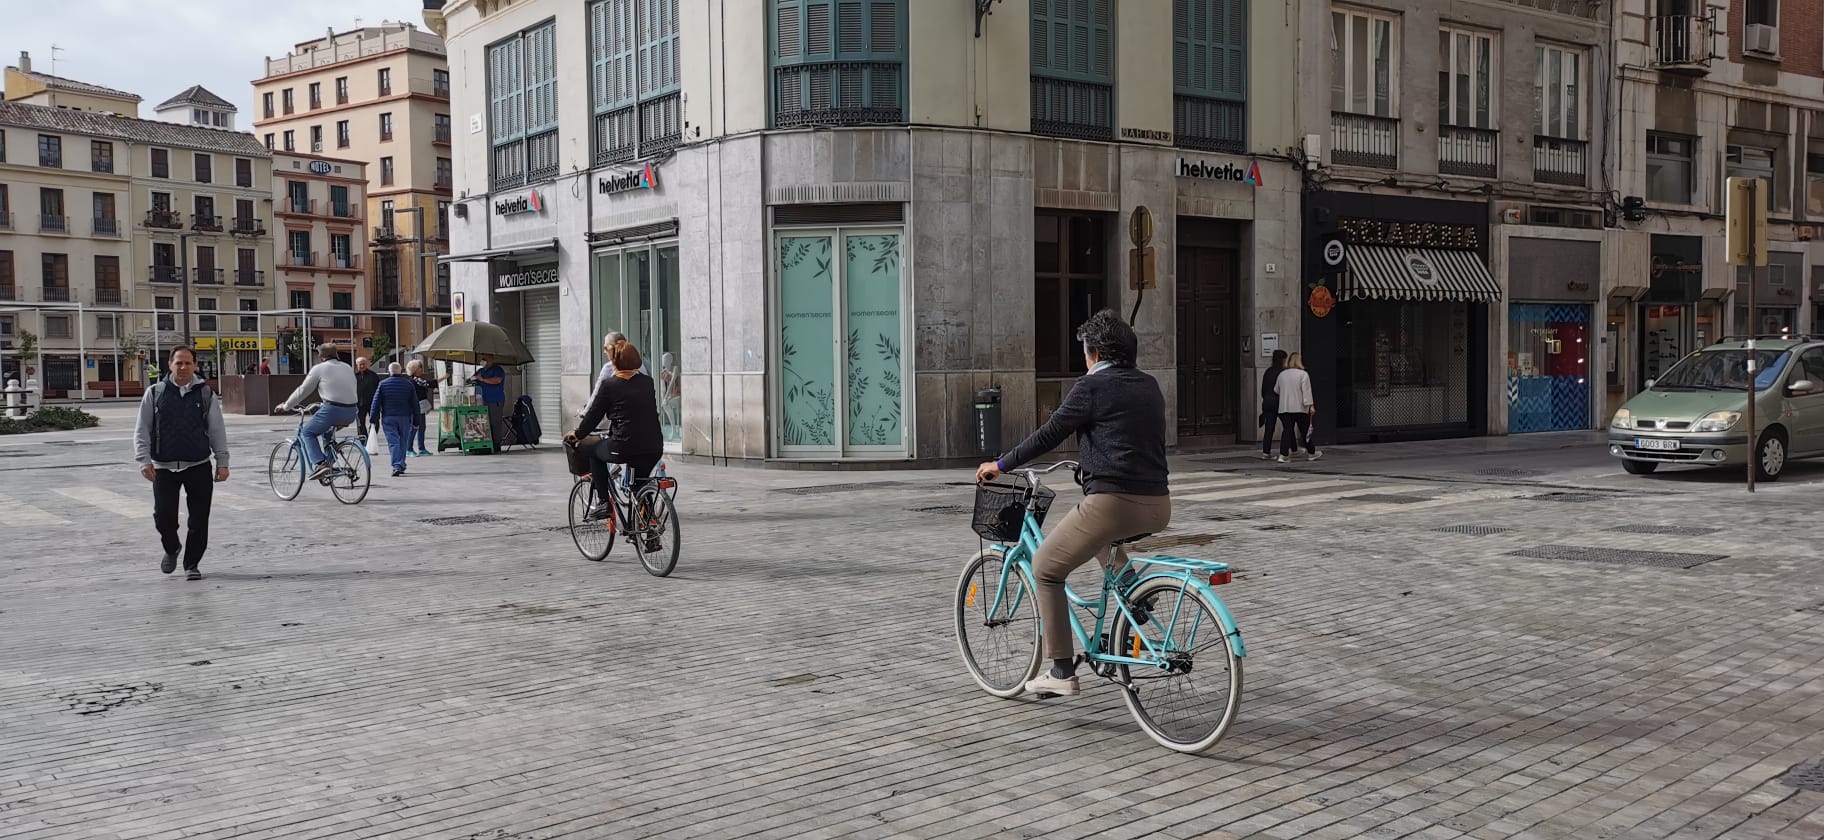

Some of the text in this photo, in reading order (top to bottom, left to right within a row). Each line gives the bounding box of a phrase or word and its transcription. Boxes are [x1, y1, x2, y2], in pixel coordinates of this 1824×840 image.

[1180, 158, 1244, 181] helvetia
[599, 170, 640, 194] helvetia
[495, 195, 528, 216] helvetia
